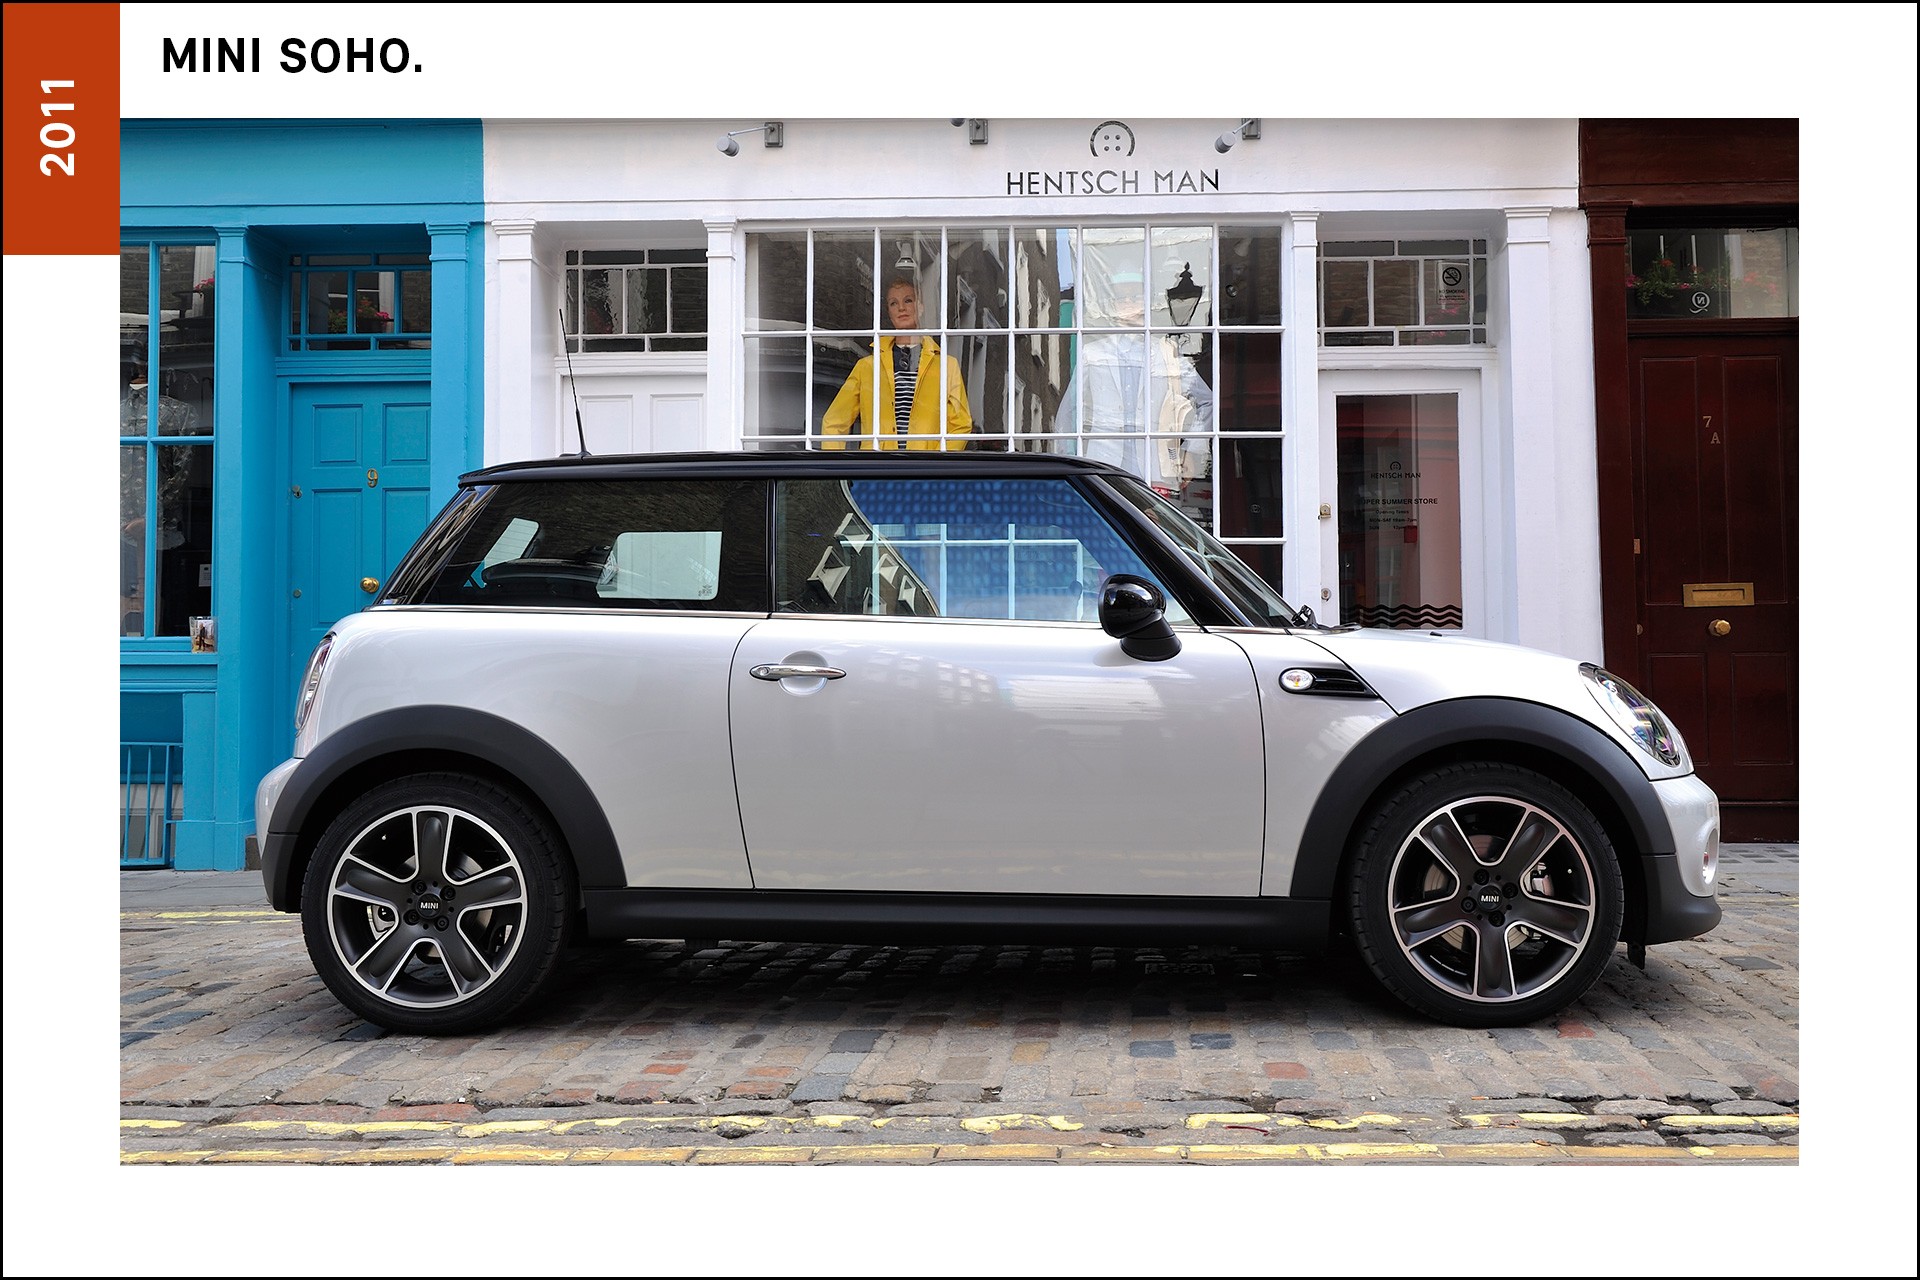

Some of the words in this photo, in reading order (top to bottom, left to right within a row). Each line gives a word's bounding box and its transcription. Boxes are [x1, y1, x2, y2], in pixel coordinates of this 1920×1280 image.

[1006, 169, 1139, 195] HENTSCH
[1153, 168, 1220, 193] MAN
[1702, 415, 1713, 428] 7
[1710, 431, 1721, 445] A
[366, 468, 379, 489] 9
[1480, 894, 1500, 903] MINI
[420, 901, 439, 910] MINI
